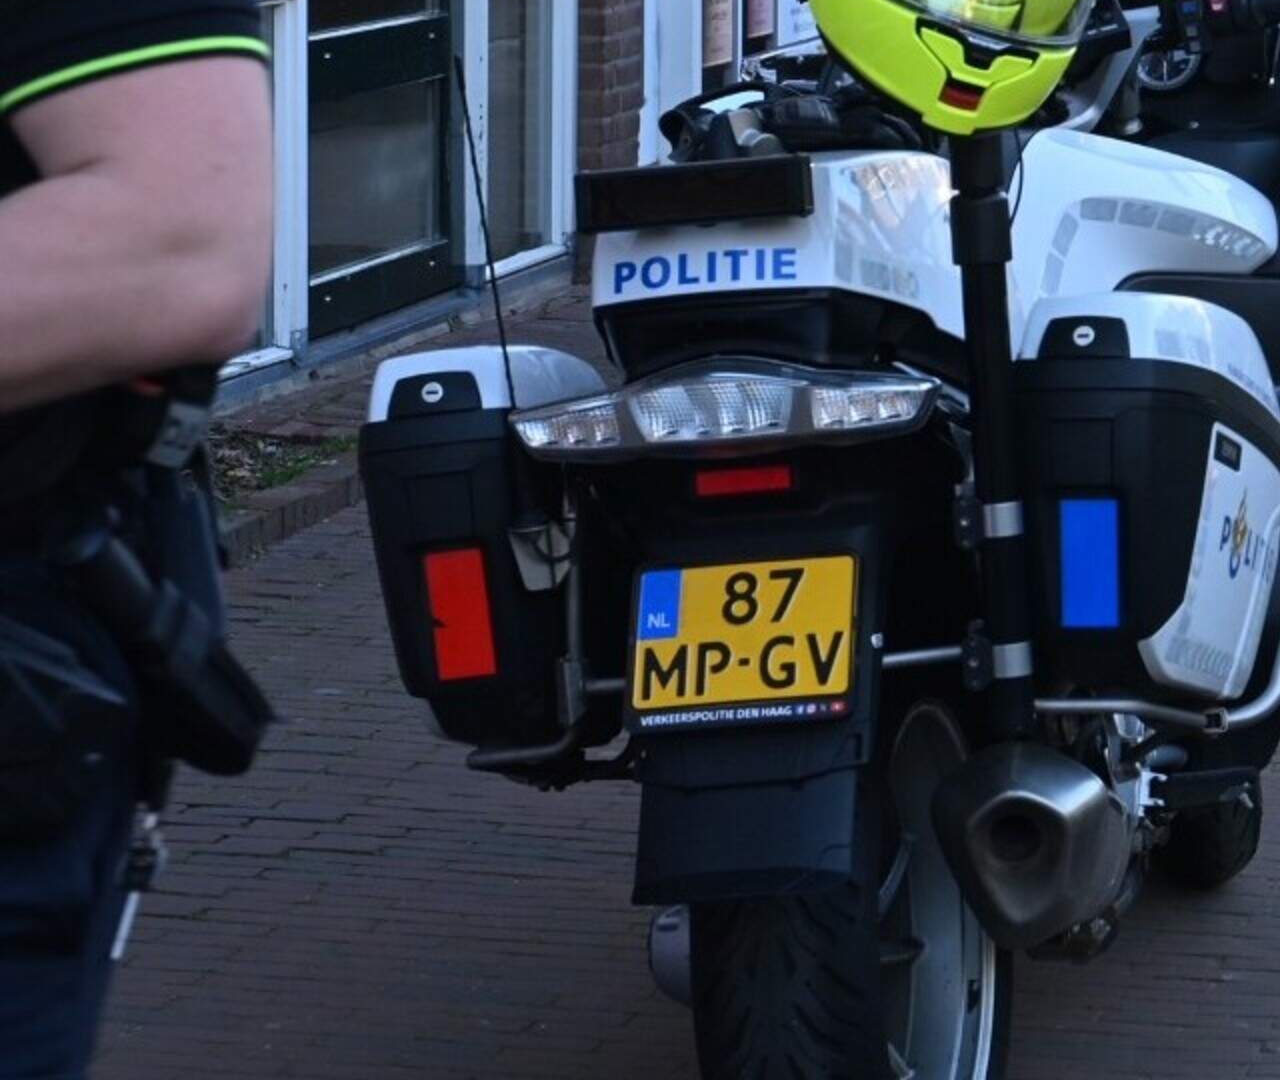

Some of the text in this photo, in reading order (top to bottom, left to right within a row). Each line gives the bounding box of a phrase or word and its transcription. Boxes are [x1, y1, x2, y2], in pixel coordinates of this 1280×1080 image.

[613, 247, 797, 294] POLITIE
[647, 612, 671, 629] NL
[721, 568, 805, 626] 87
[641, 631, 845, 701] MP-GV
[640, 705, 793, 727] VERKEERSPOLITIE DEN HAAG
